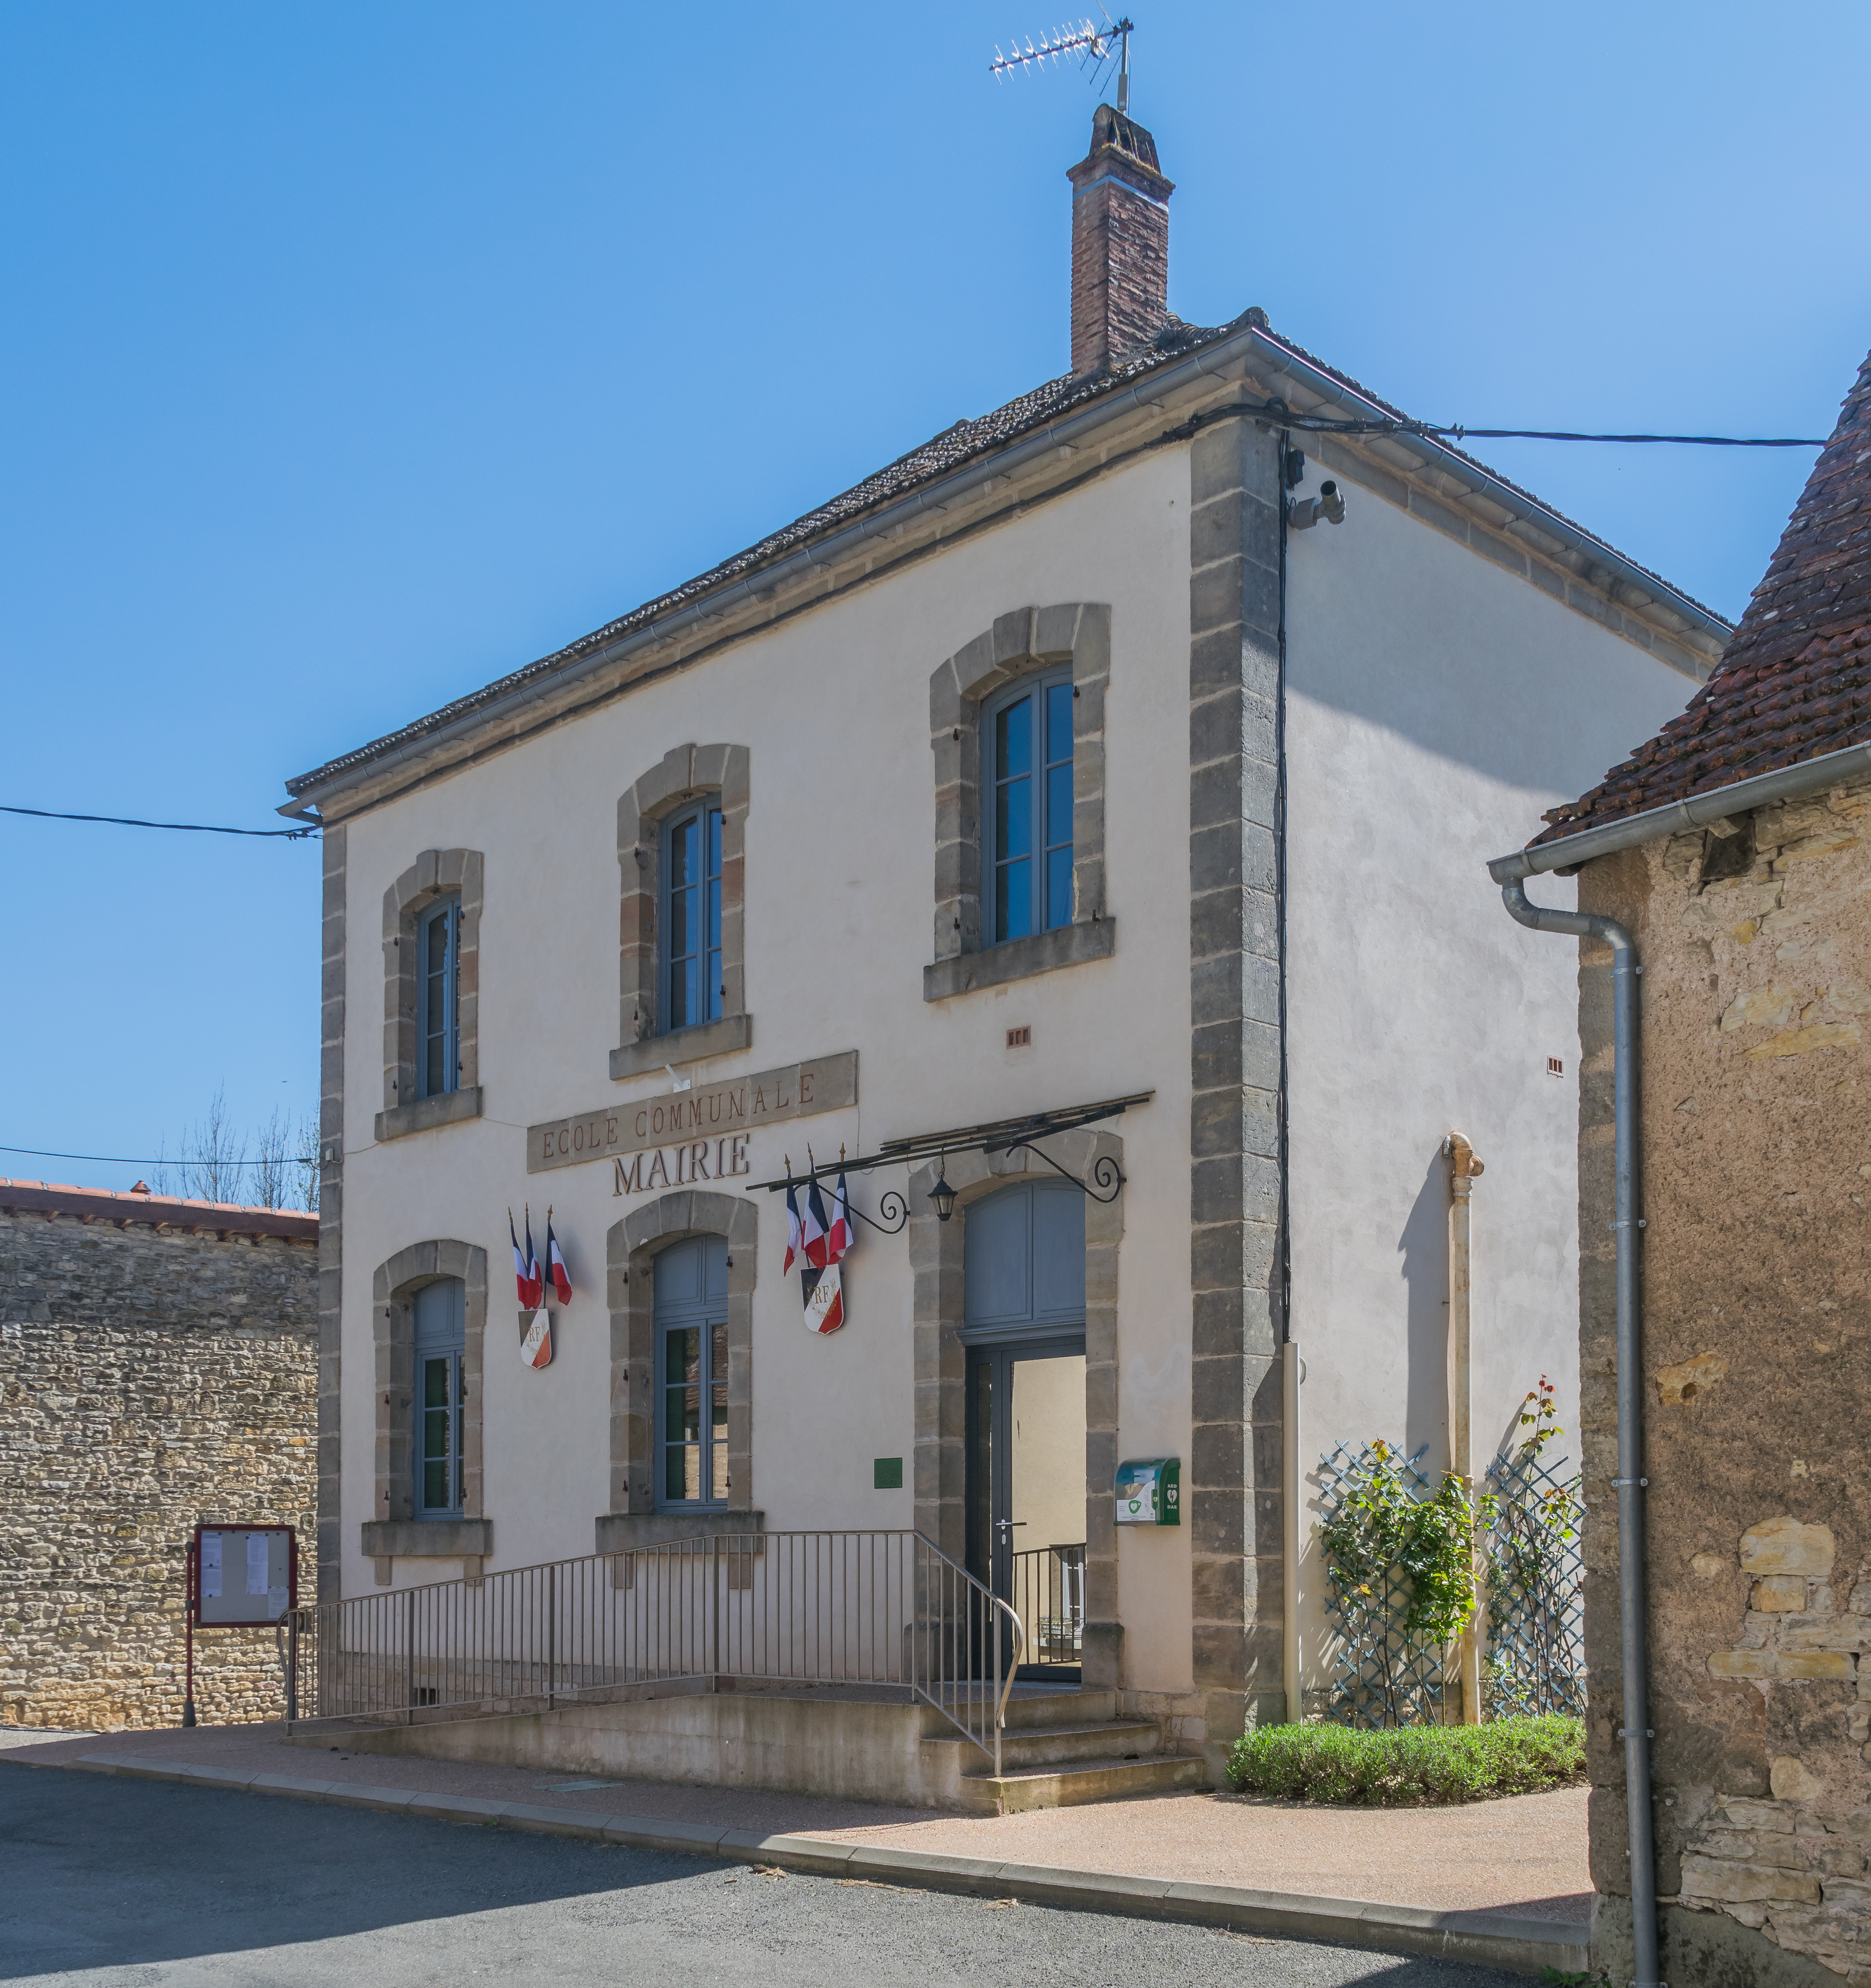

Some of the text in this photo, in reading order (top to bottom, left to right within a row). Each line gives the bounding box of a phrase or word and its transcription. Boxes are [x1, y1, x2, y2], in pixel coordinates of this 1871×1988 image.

[543, 1074, 814, 1158] ECOLE COMMUNALE
[612, 1133, 749, 1196] MAIRIE
[813, 1286, 829, 1303] RF
[529, 1327, 540, 1341] RF
